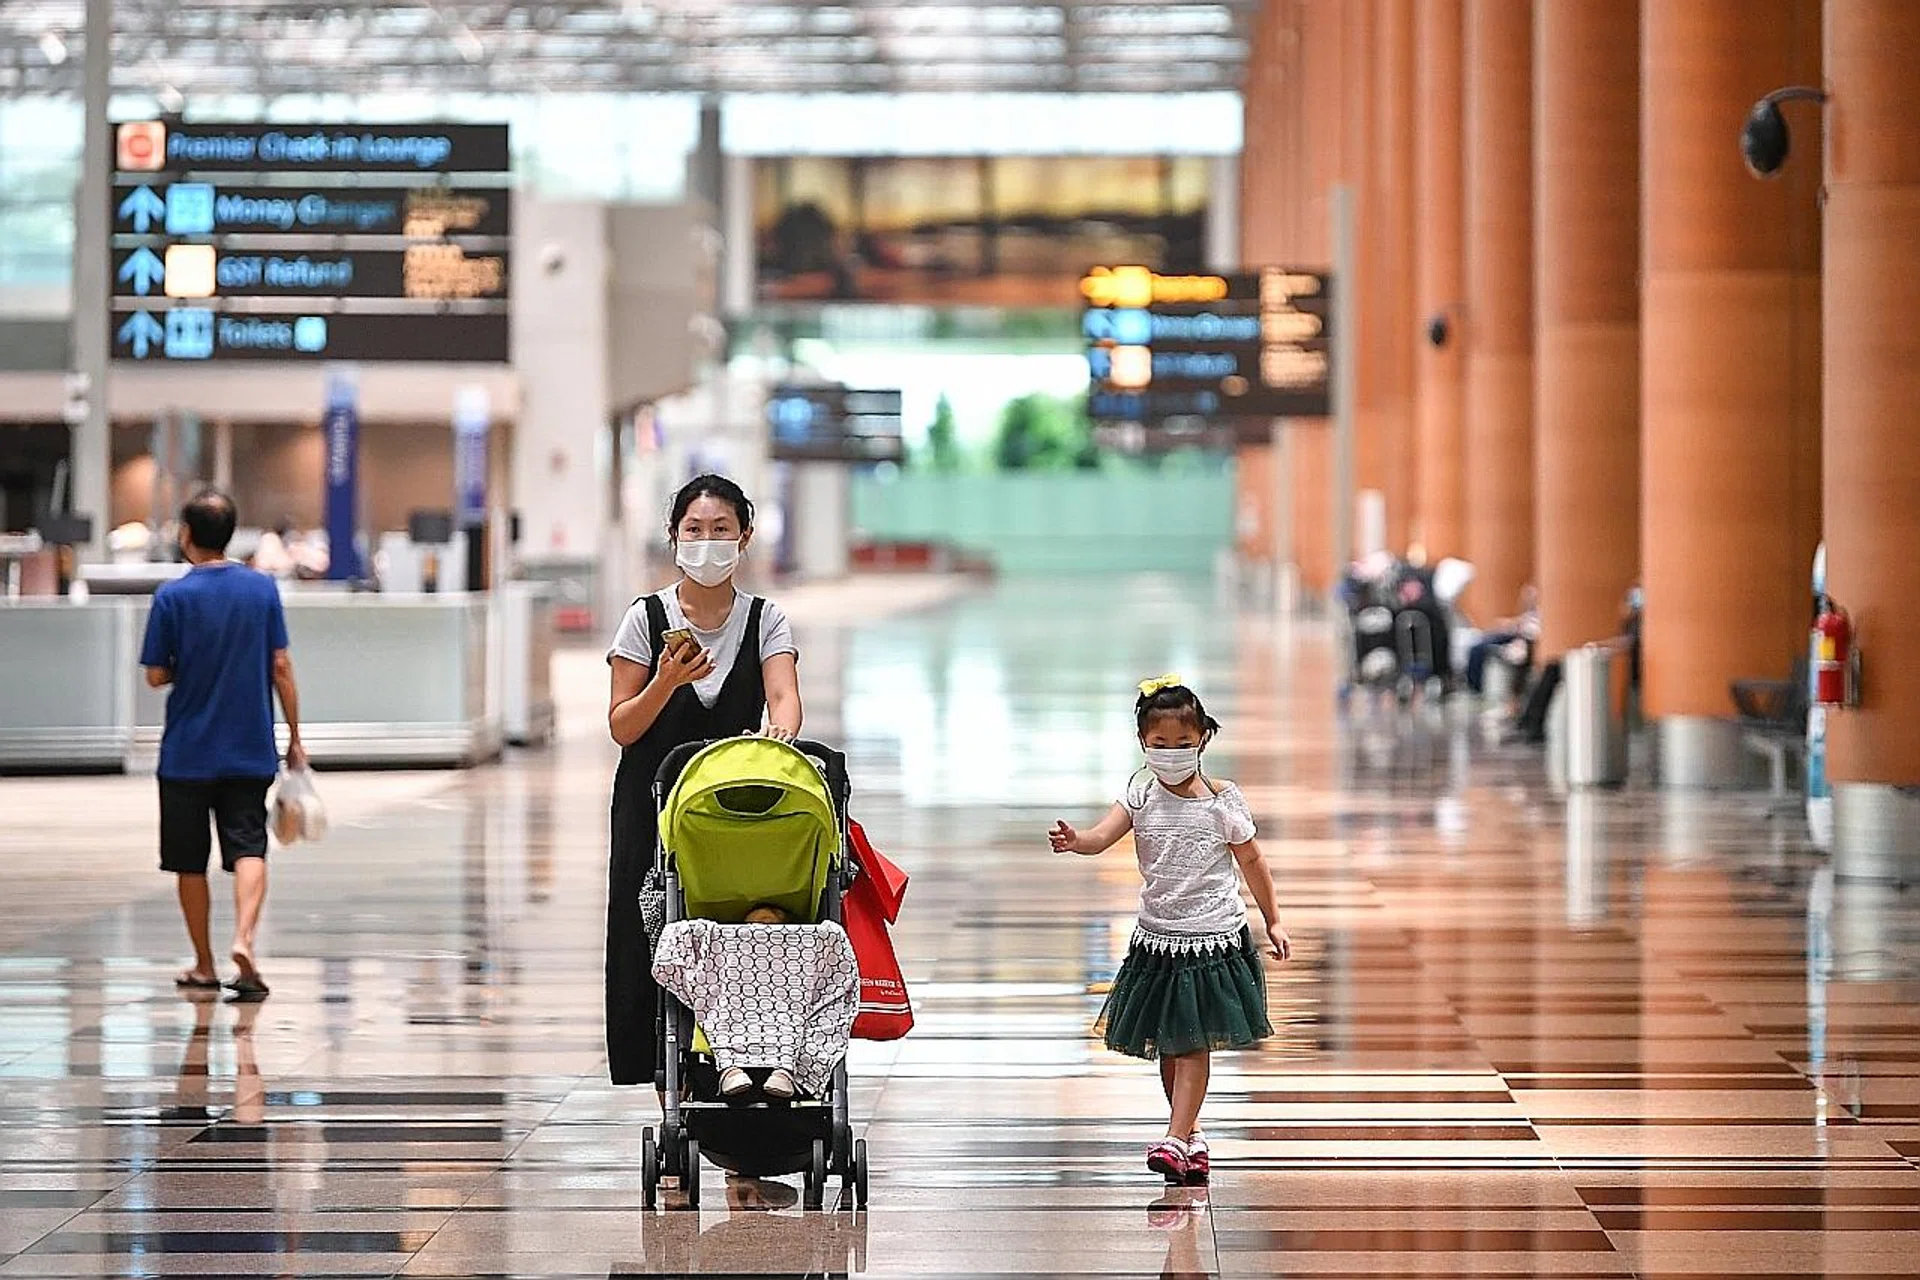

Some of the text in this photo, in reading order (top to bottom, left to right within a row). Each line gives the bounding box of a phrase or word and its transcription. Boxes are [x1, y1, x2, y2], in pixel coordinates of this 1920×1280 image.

[167, 132, 256, 161] Premier
[360, 132, 452, 168] Lounge
[216, 194, 296, 230] Money
[217, 255, 354, 288] GST Refund
[219, 317, 293, 350] Toilets
